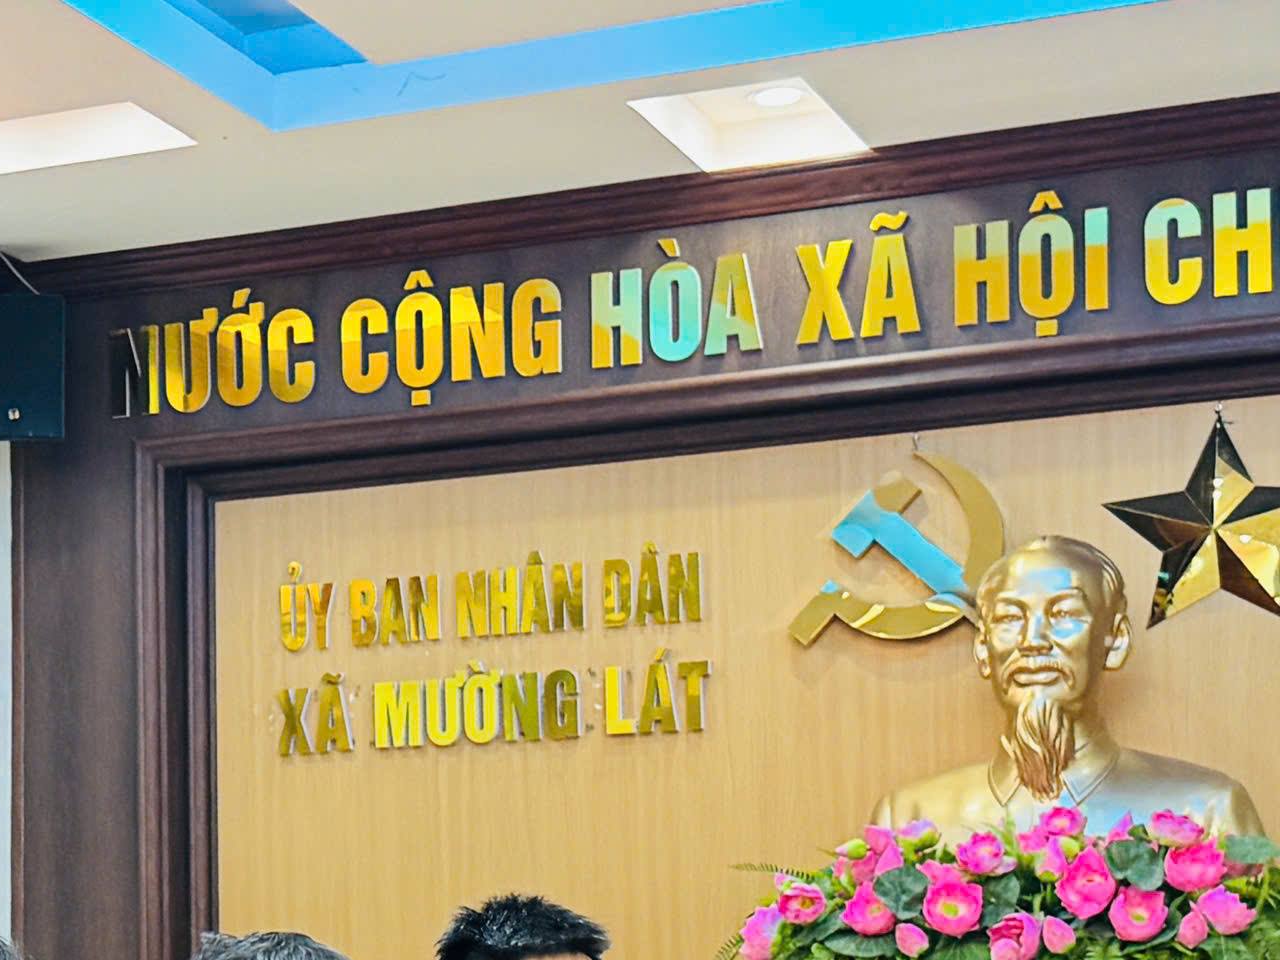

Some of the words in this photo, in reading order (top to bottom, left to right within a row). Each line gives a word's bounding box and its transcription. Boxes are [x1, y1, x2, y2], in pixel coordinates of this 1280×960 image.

[110, 287, 315, 418] NƯỚC
[340, 269, 562, 406] CỘNG
[591, 238, 763, 369] HÒA
[795, 210, 921, 346] XÃ
[953, 189, 1109, 338] HỘI
[1143, 187, 1273, 306] CH
[279, 560, 336, 652] ỦY
[349, 574, 441, 648] BAN
[455, 549, 585, 639] NHÂN
[601, 540, 702, 629] DÂN
[276, 671, 356, 757] XÃ
[372, 659, 584, 750] MƯỜNG
[603, 647, 712, 736] LÁT
